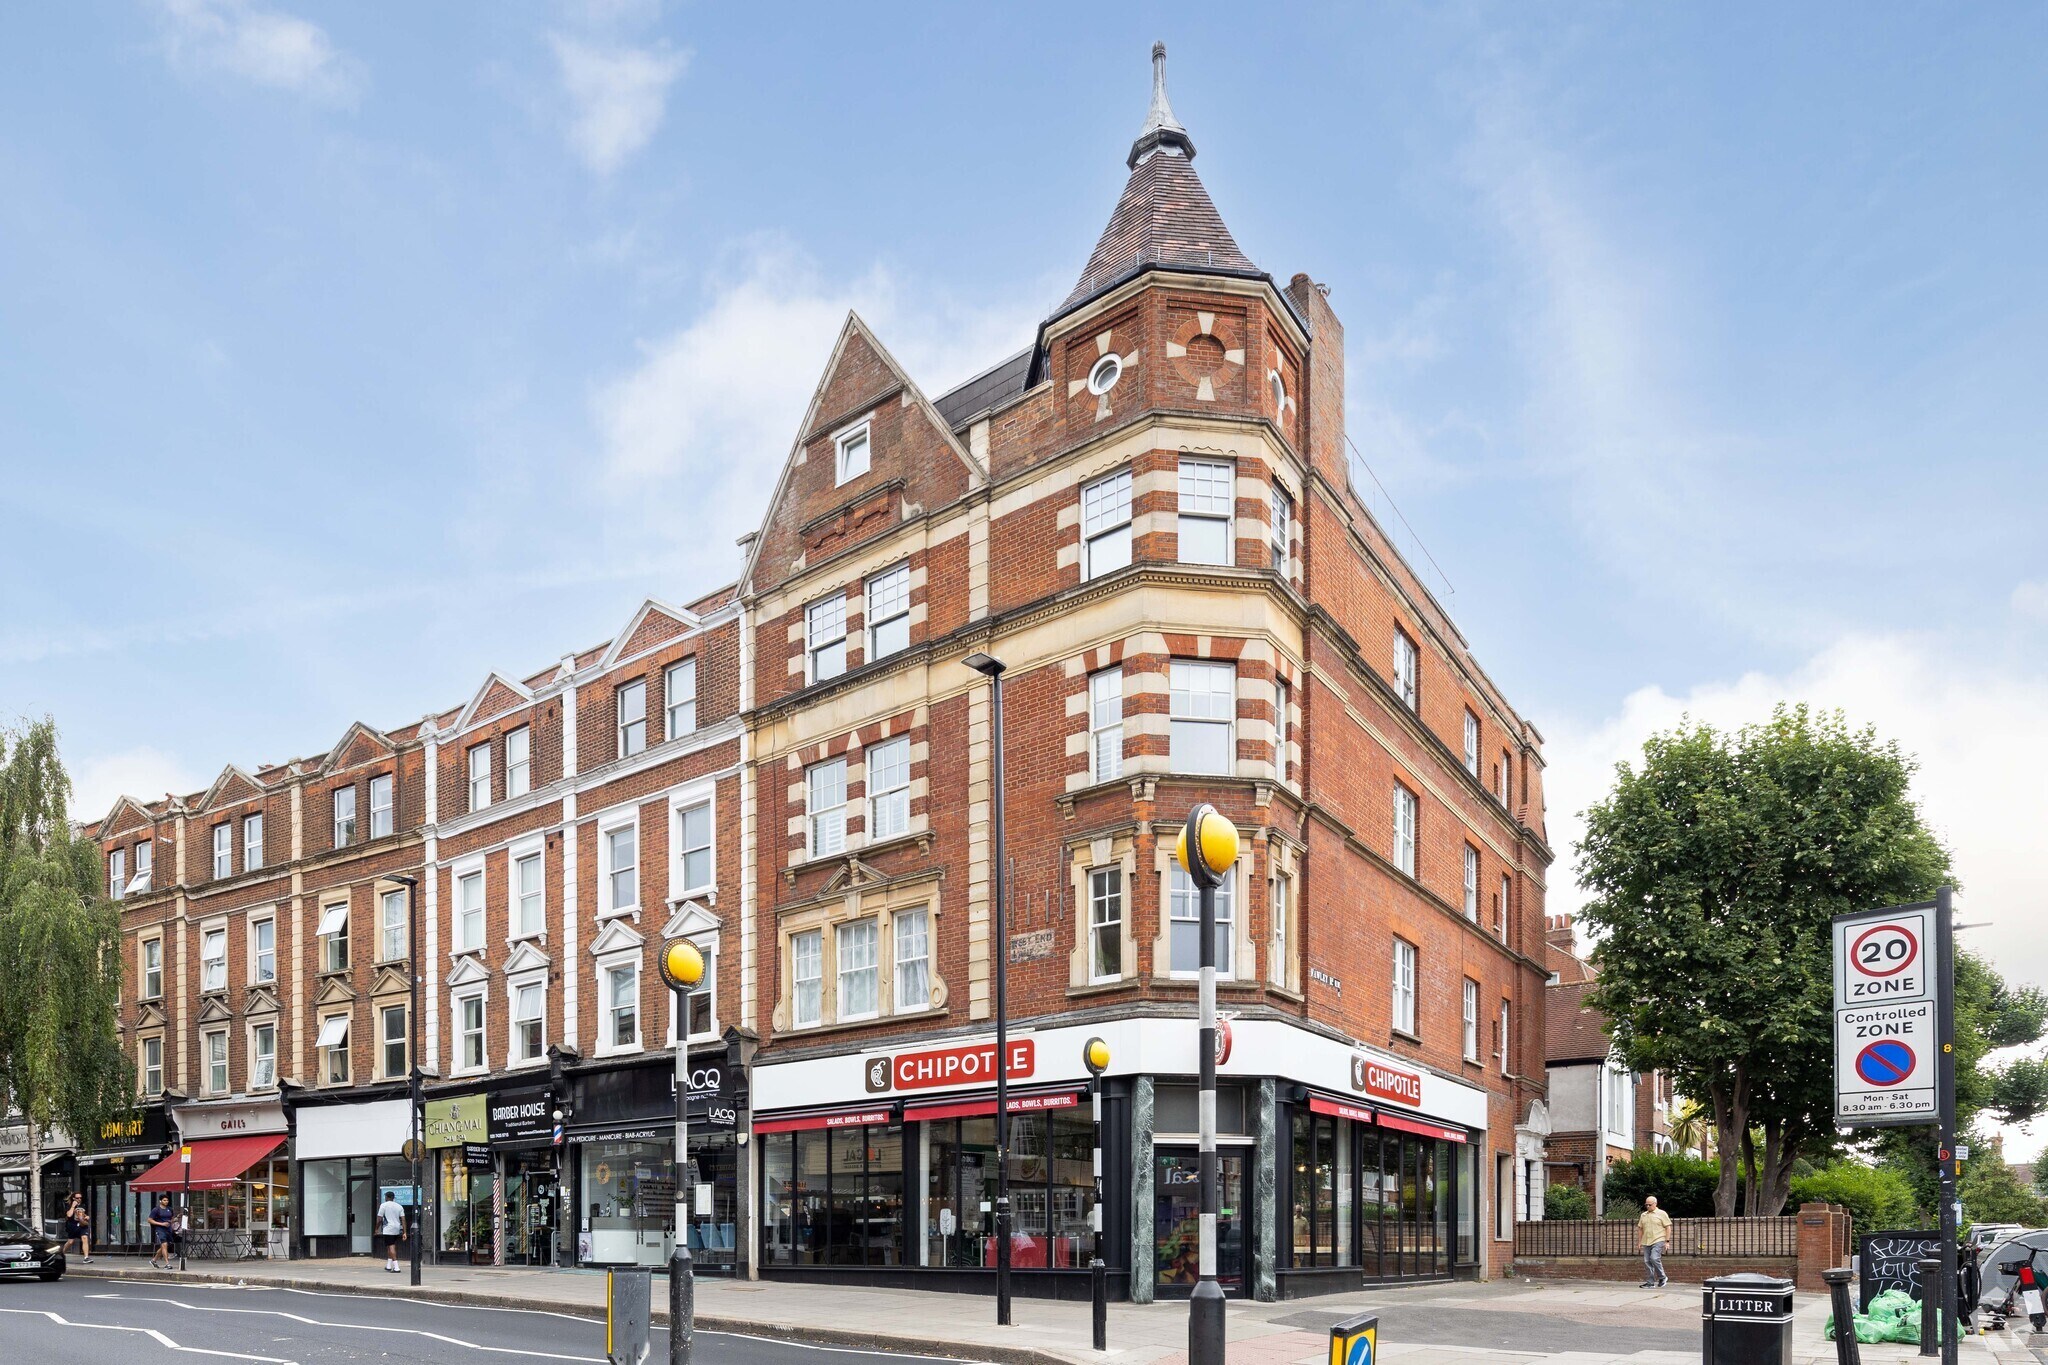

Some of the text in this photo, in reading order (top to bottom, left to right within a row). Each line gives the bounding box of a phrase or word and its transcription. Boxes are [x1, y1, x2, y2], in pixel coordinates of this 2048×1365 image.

[1862, 939, 1907, 963] 20
[1853, 977, 1915, 996] ZONE
[1845, 1007, 1926, 1024] Controlled
[1856, 1021, 1914, 1038] ZONE
[1943, 1043, 1952, 1053] 8
[1368, 1066, 1419, 1099] CHIPOTLE
[1021, 1099, 1043, 1108] BOWLS,
[1043, 1096, 1072, 1106] BURRITOS.
[1843, 1104, 1866, 1112] 8.30
[1889, 1101, 1913, 1109] 6.30
[1915, 1101, 1930, 1109] pm
[492, 1102, 545, 1121] BARBER HOUSE
[709, 1107, 736, 1121] LACQ
[429, 1118, 482, 1135] CHIANG MAI
[599, 1132, 623, 1141] MANICURE
[1719, 1299, 1774, 1313] LITTER
